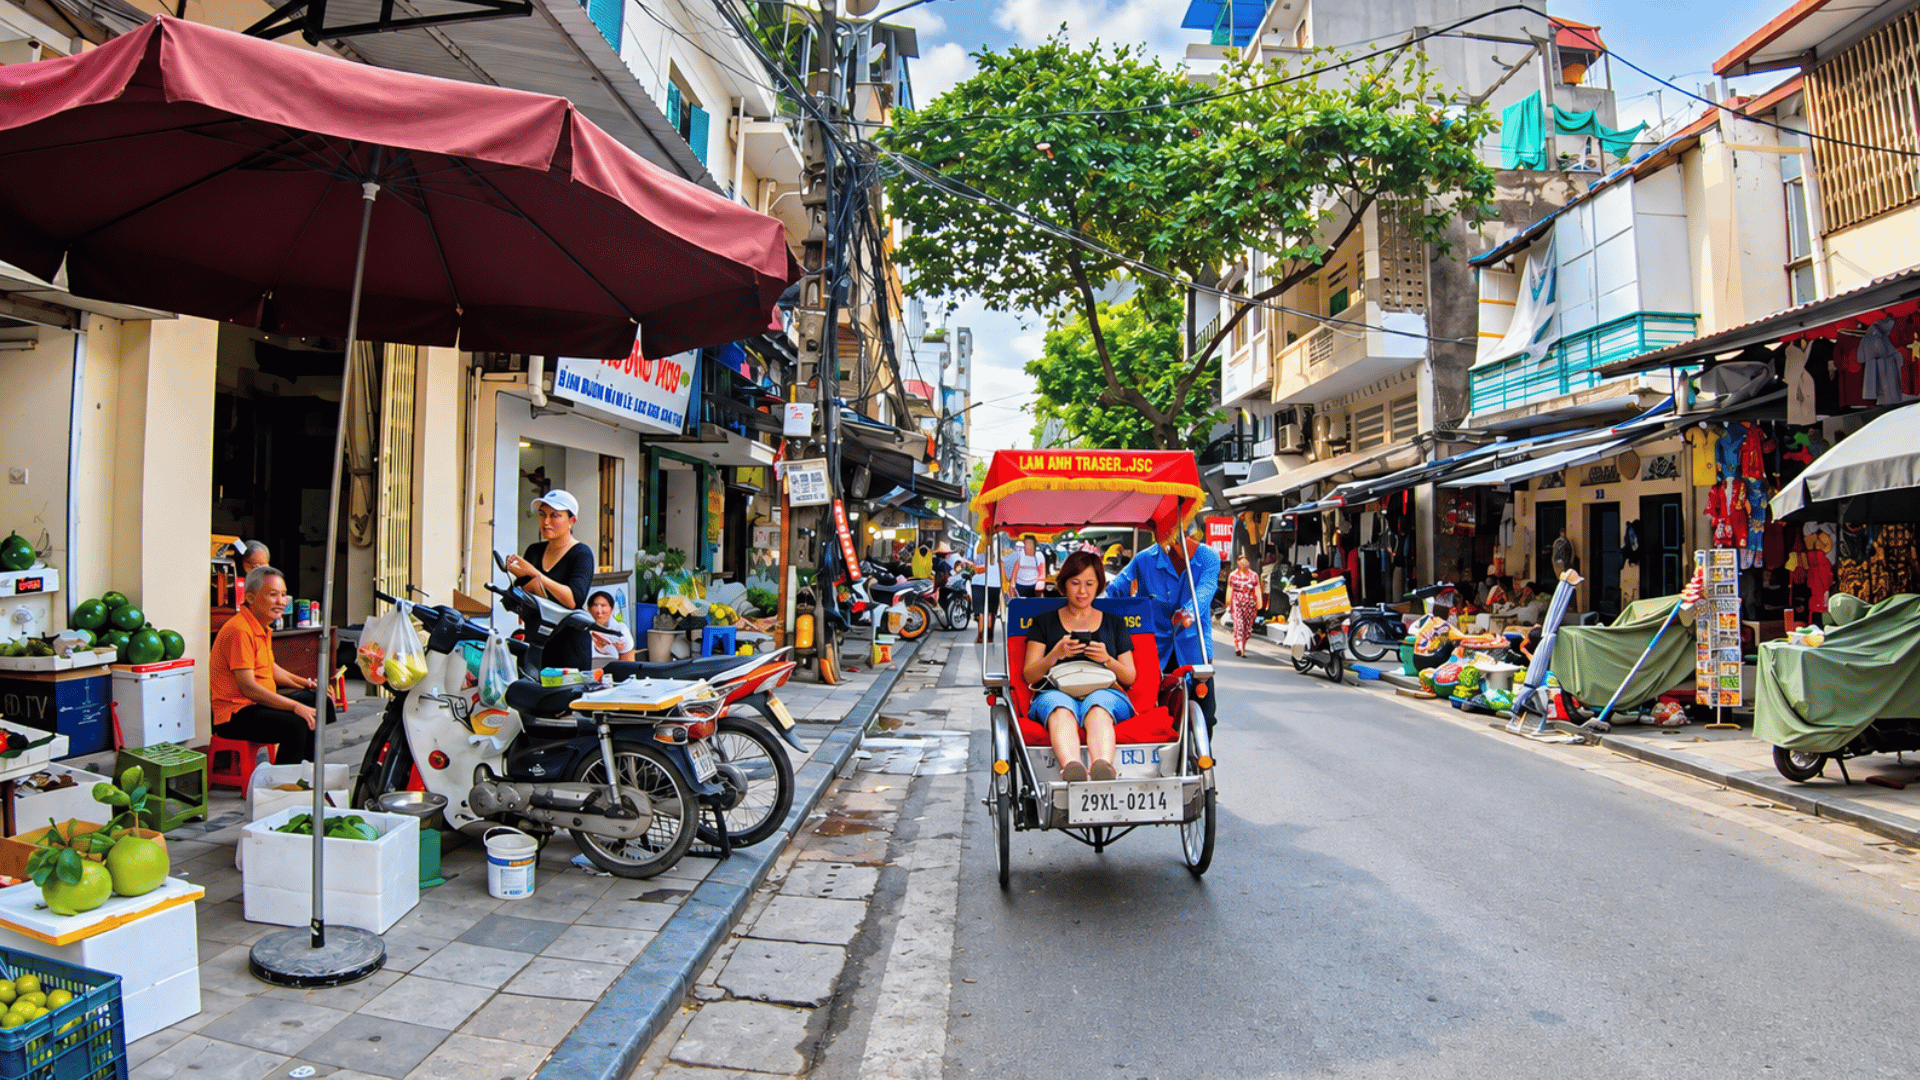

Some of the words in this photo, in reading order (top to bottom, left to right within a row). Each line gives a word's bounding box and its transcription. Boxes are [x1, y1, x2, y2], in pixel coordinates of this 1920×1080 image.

[1019, 455, 1044, 470] LAM
[1047, 456, 1072, 470] ANH
[1081, 791, 1167, 812] 29XL-0214
